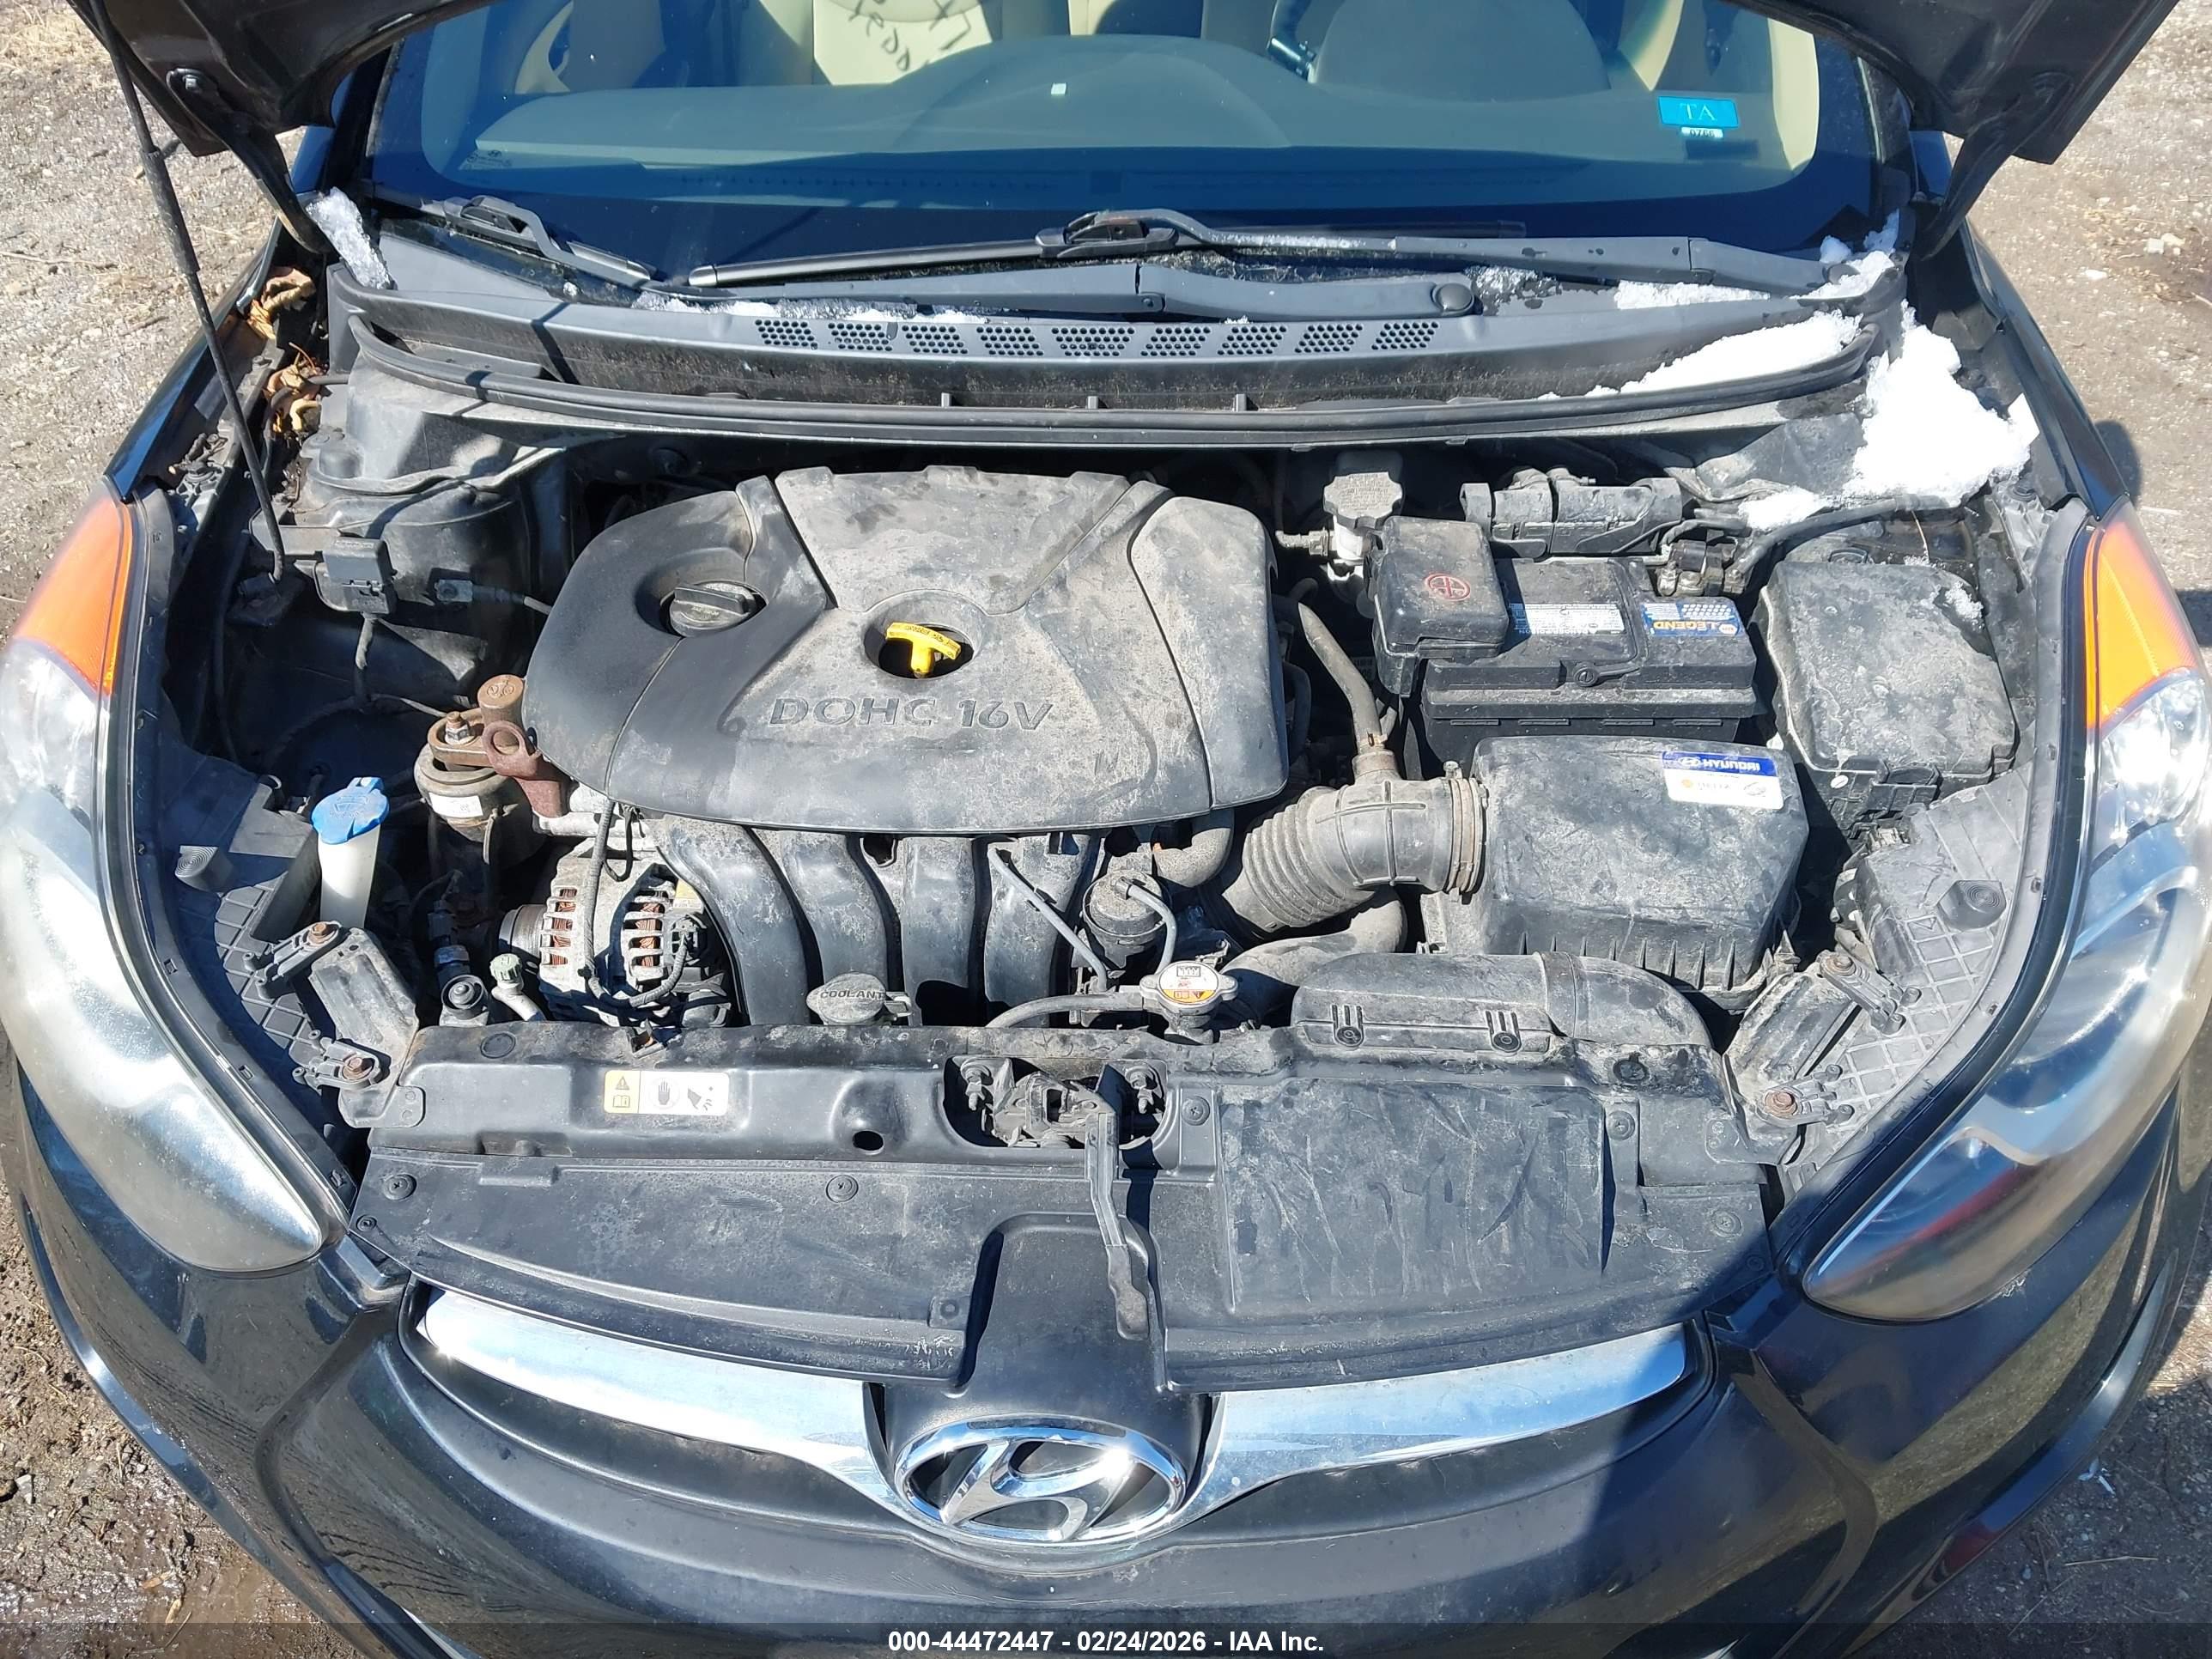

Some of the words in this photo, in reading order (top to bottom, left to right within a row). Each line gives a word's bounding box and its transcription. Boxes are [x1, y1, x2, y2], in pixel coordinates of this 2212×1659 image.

[1680, 102, 1717, 121] TA
[1653, 620, 1720, 631] LEGEND
[769, 697, 937, 726] DOHC
[957, 699, 1054, 731] 16V
[1703, 758, 1761, 771] HYUNDAI
[820, 990, 885, 1000] COOLANT
